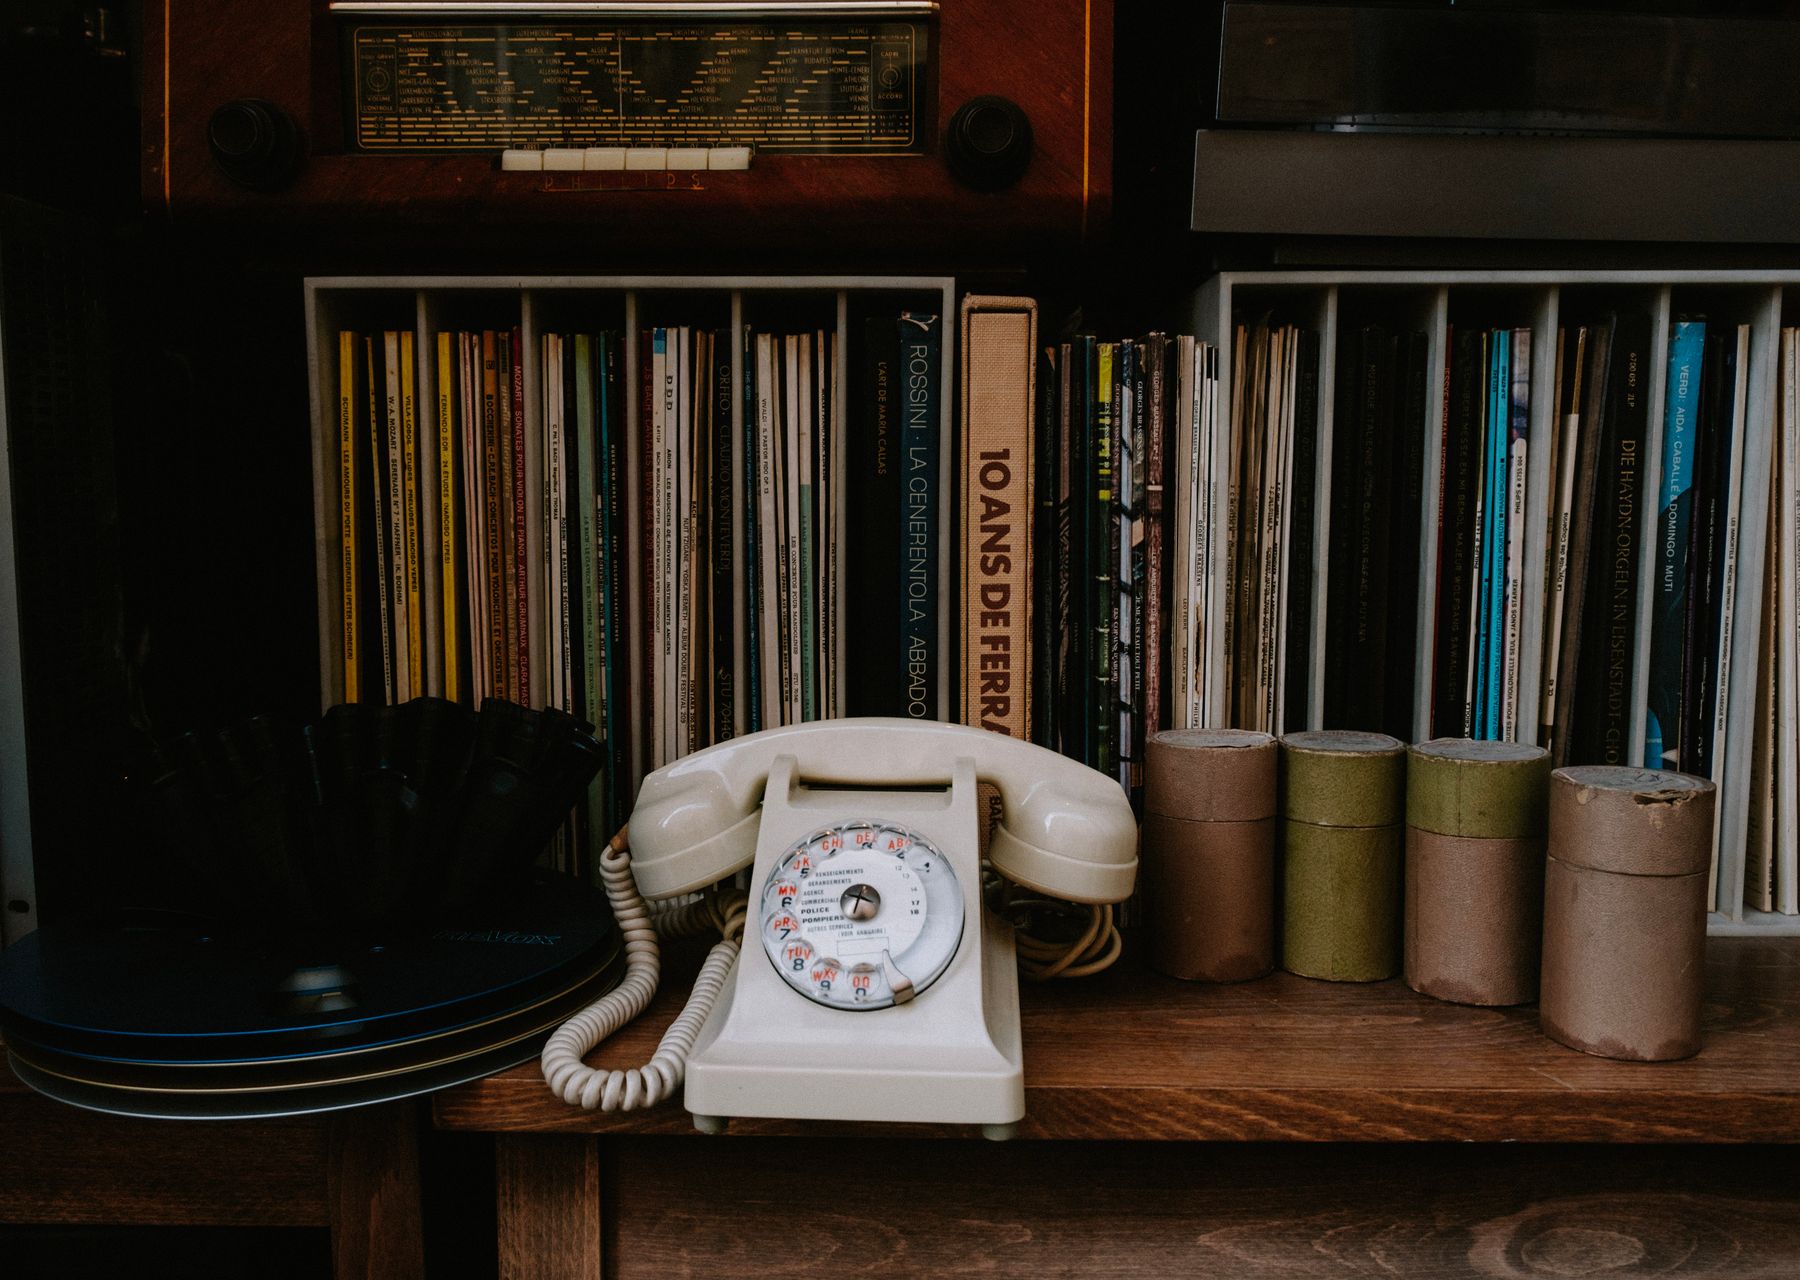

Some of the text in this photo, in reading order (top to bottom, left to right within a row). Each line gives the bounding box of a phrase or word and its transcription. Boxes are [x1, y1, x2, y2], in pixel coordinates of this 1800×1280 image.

[1628, 352, 1638, 372] 6700
[514, 365, 522, 401] MOZART
[1136, 381, 1144, 414] GEORGES
[389, 418, 397, 450] MOZART
[514, 410, 523, 450] SONATES
[877, 362, 887, 475] L'ART DE MARIA CALLAS
[1674, 406, 1686, 432] AIDA
[442, 460, 449, 468] 24
[720, 424, 730, 482] CLAUDIO
[980, 448, 1011, 491] 10
[1620, 440, 1636, 466] DIE
[1670, 441, 1683, 492] CABALLÉ
[391, 458, 399, 498] SERENADE
[516, 480, 524, 513] VIOLON
[517, 516, 525, 525] ET
[720, 486, 731, 571] MONTEVERDI
[908, 345, 928, 717] ROSSINI LA CENERENTOLA ABBADO
[980, 494, 1011, 574] ANS
[1666, 503, 1678, 558] DOMINGO
[486, 394, 503, 684] BOCCHERINI CONCERTOS POUR VIOLONCELLE ET ORCHESTRE
[517, 529, 526, 556] PIANO
[344, 546, 352, 593] LIEDERKREIS
[518, 564, 526, 600] ARTHUR
[1664, 564, 1674, 592] MUTI
[980, 584, 1011, 627] DE
[1612, 605, 1628, 621] IN
[518, 602, 527, 648] GRUMIAUX
[520, 656, 528, 684] CLARA
[720, 673, 732, 697] STU
[1506, 658, 1515, 699] VIOLONCELLE
[1607, 626, 1626, 719] EISENSTADT
[801, 906, 830, 914] POLICE
[802, 916, 845, 924] POMPIERS
[780, 928, 791, 940] 7
[793, 958, 804, 971] 8
[820, 980, 831, 991] 9
